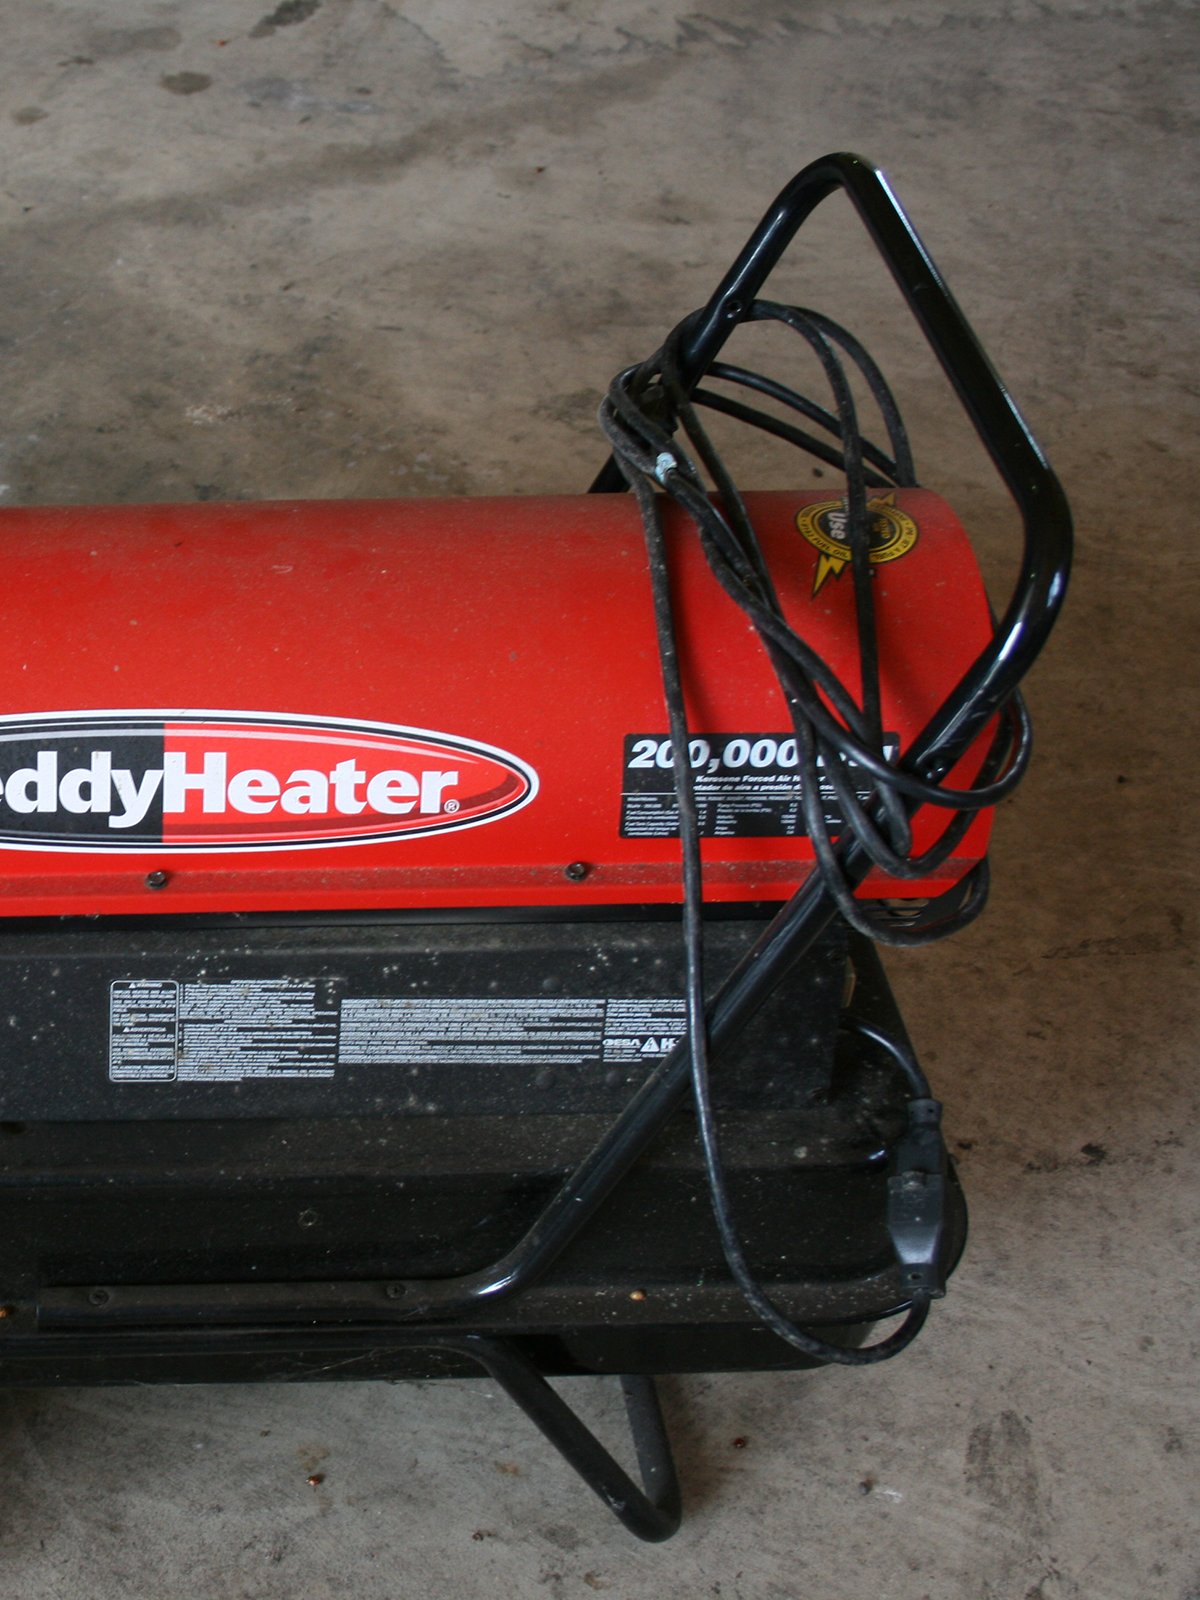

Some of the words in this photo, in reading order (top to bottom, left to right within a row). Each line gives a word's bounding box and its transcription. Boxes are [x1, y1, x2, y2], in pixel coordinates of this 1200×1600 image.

[627, 738, 799, 774] 200,000
[695, 774, 741, 783] Kerosene
[742, 774, 777, 783] Forced
[776, 774, 792, 783] Air
